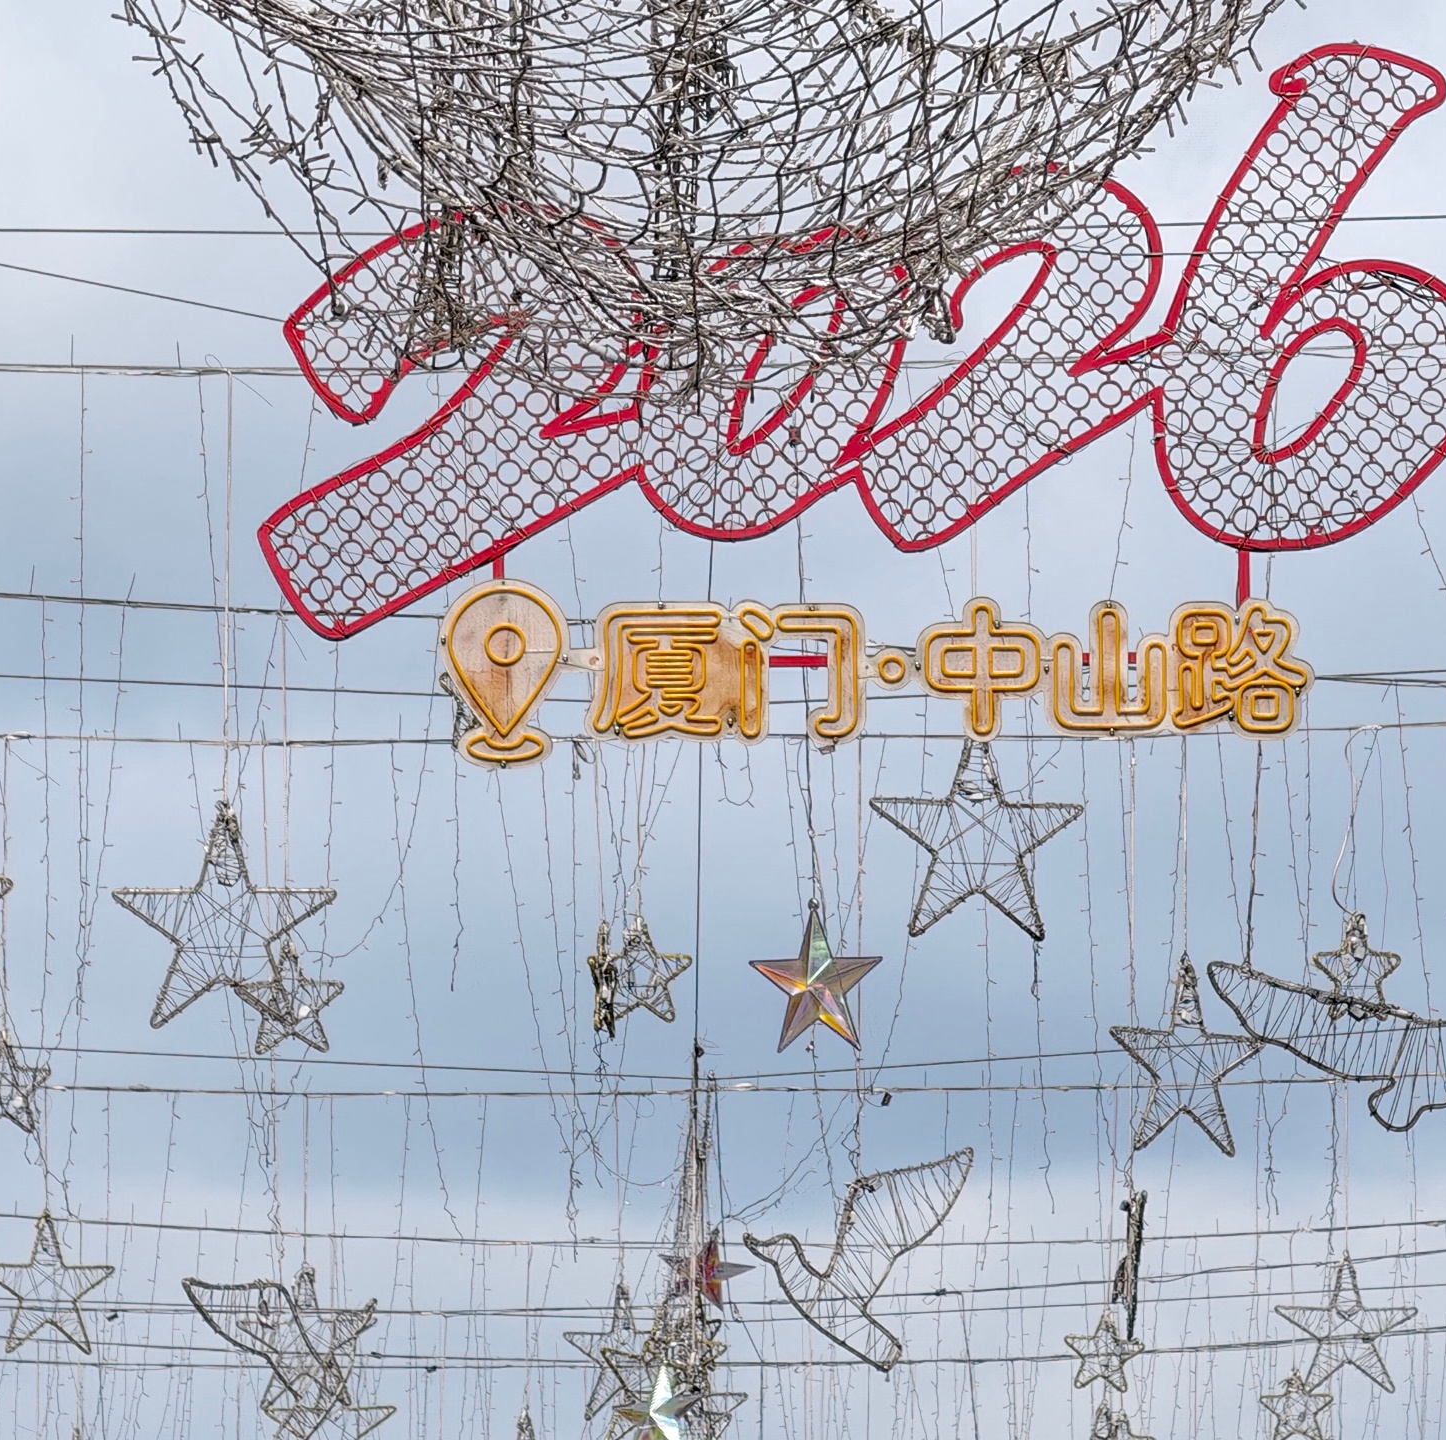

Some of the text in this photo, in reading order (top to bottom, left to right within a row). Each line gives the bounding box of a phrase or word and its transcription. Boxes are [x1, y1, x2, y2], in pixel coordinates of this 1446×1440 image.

[591, 598, 1309, 740] 厦门·中山路
